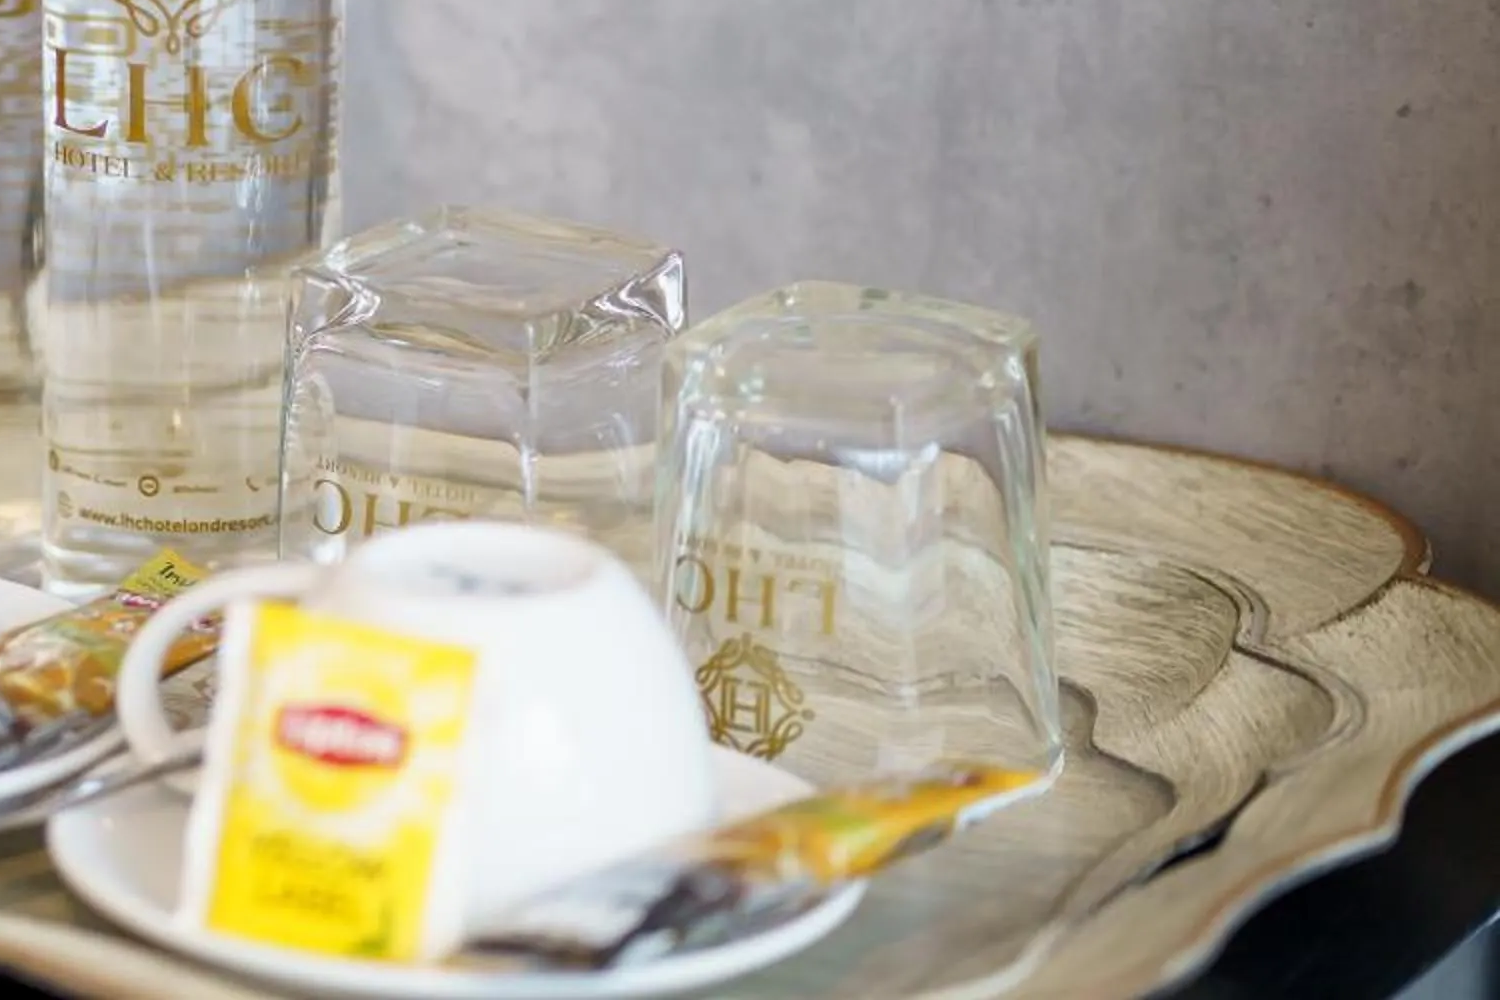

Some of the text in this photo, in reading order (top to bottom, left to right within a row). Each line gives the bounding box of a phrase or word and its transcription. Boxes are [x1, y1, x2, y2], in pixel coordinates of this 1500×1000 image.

[54, 48, 304, 147] LHC
[55, 142, 132, 179] HOTEL
[312, 478, 471, 537] HC
[676, 553, 837, 636] LHC
